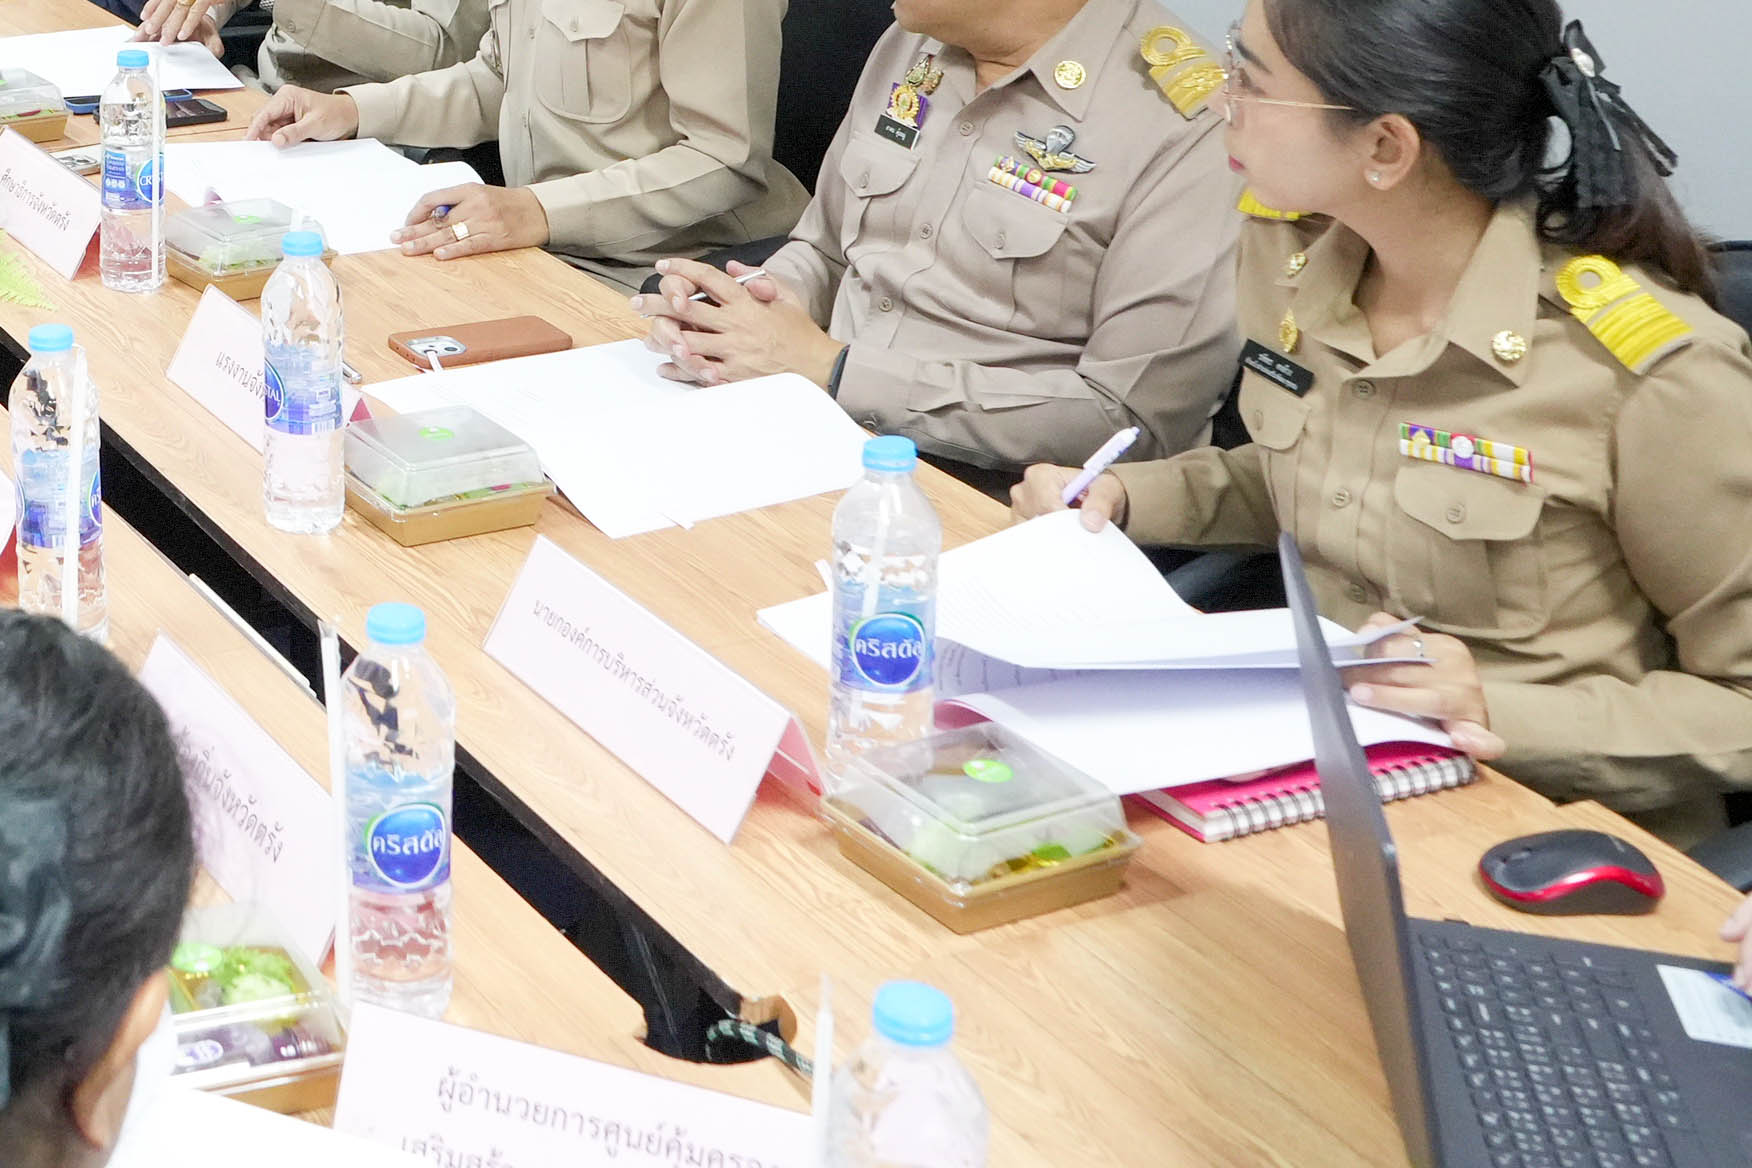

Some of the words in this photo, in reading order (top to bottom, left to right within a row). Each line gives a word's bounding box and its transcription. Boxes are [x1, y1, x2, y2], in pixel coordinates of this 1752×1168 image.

[533, 600, 736, 761] นายกองค์การบริหารส่วนจังหวัดตรัง
[437, 1064, 782, 1168] ผู้อำนวยการศูนย์คุ้มคร
